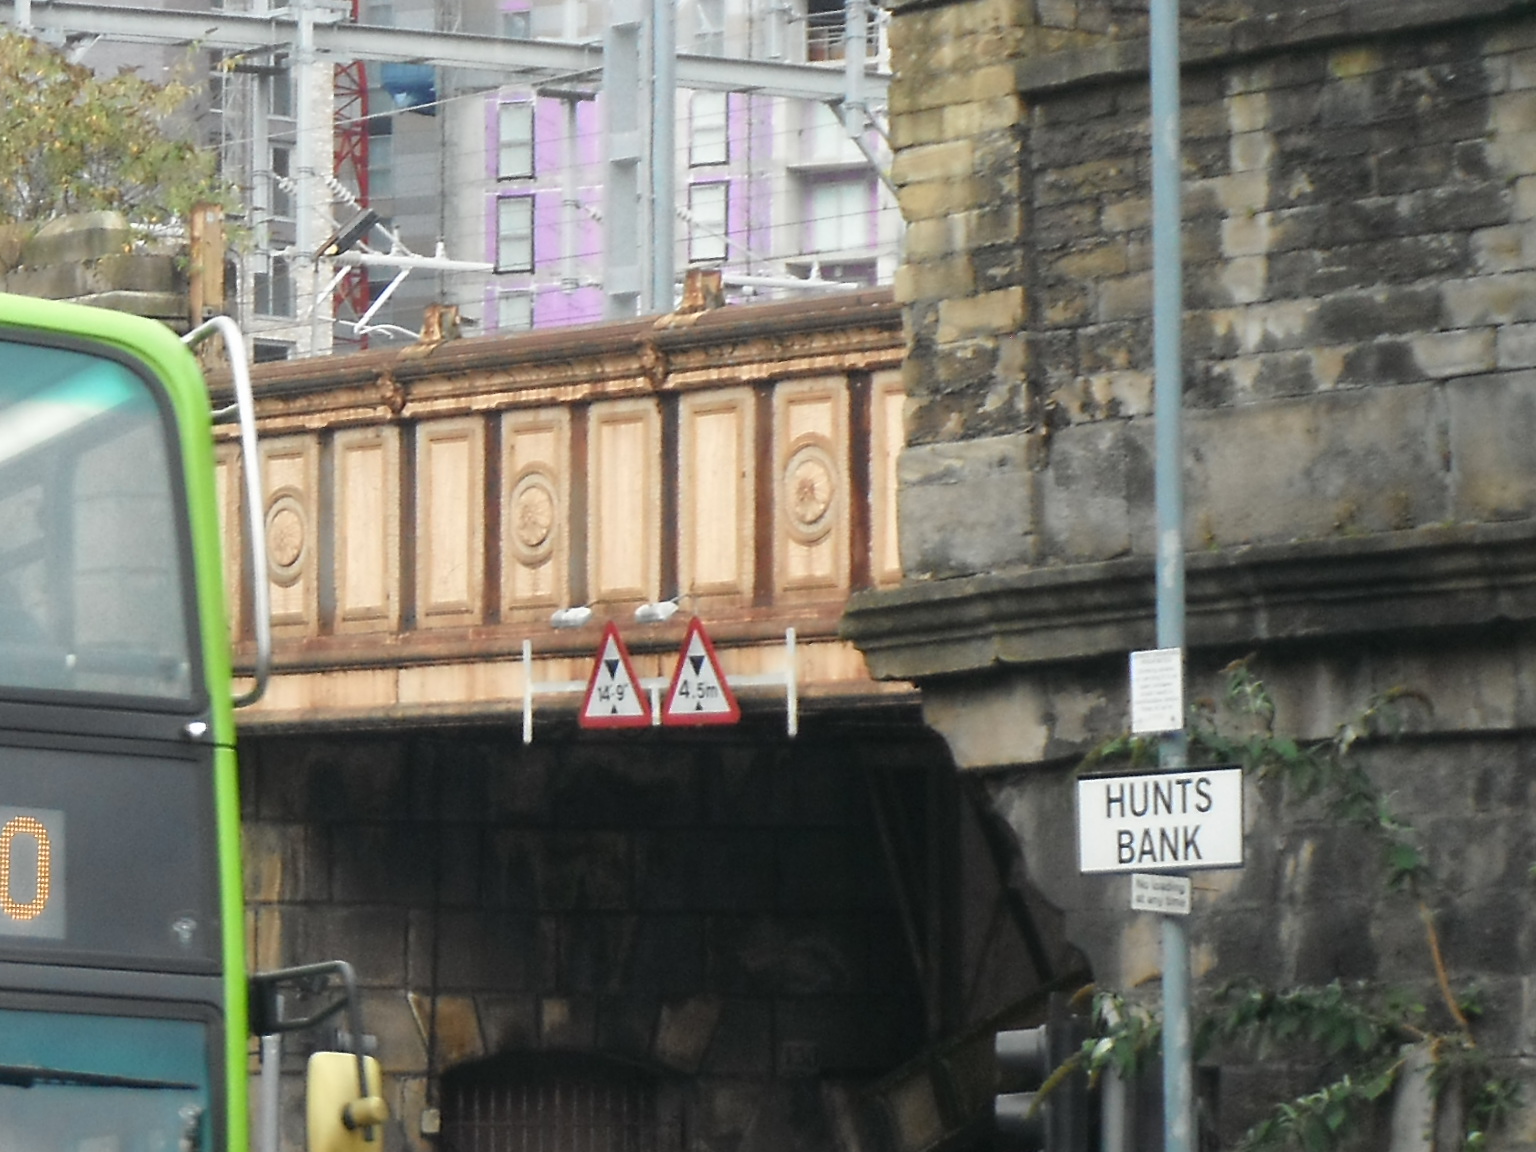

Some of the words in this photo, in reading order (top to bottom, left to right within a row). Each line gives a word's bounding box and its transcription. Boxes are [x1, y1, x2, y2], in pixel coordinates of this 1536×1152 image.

[678, 679, 718, 699] 4.5m
[1105, 777, 1212, 819] HUNTS
[1117, 825, 1202, 864] BANK
